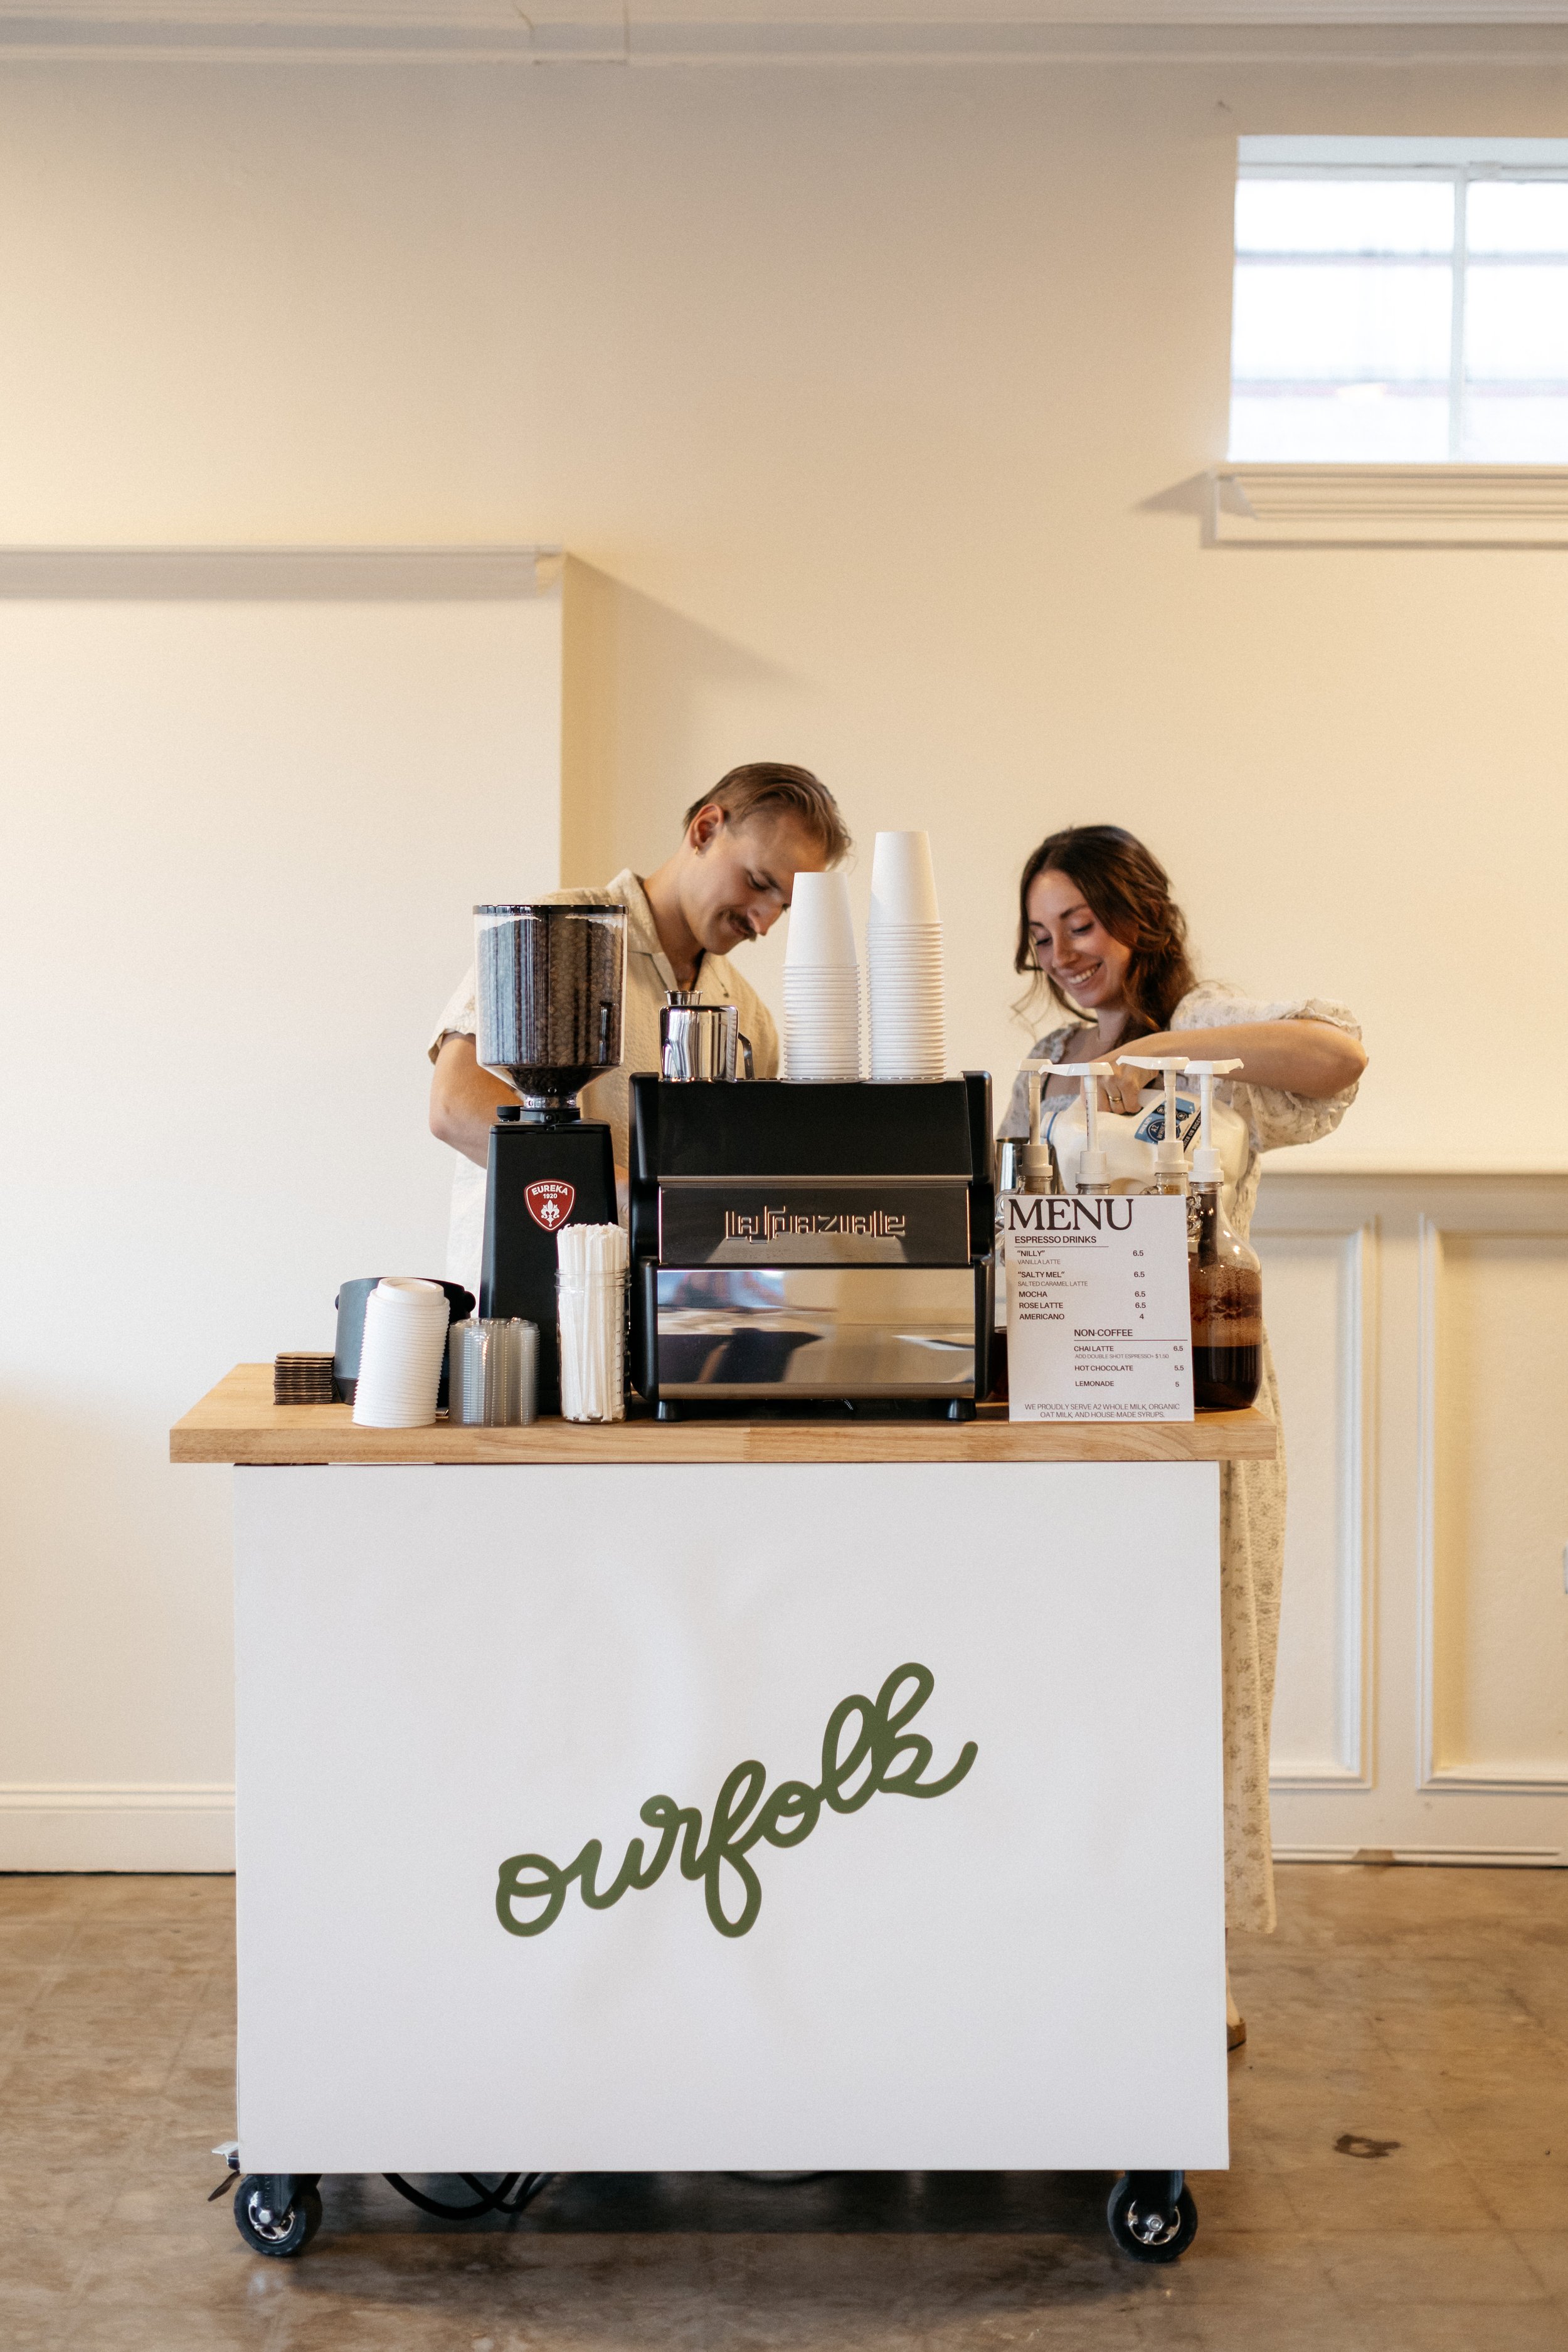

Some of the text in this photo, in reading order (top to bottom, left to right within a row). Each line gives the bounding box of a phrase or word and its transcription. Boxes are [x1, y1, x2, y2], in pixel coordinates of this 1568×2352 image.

[531, 1184, 568, 1196] EUREKA
[1008, 1199, 1134, 1231] MENU
[1015, 1236, 1061, 1244] ESPRESSO
[495, 1662, 978, 1938] ourfolk
